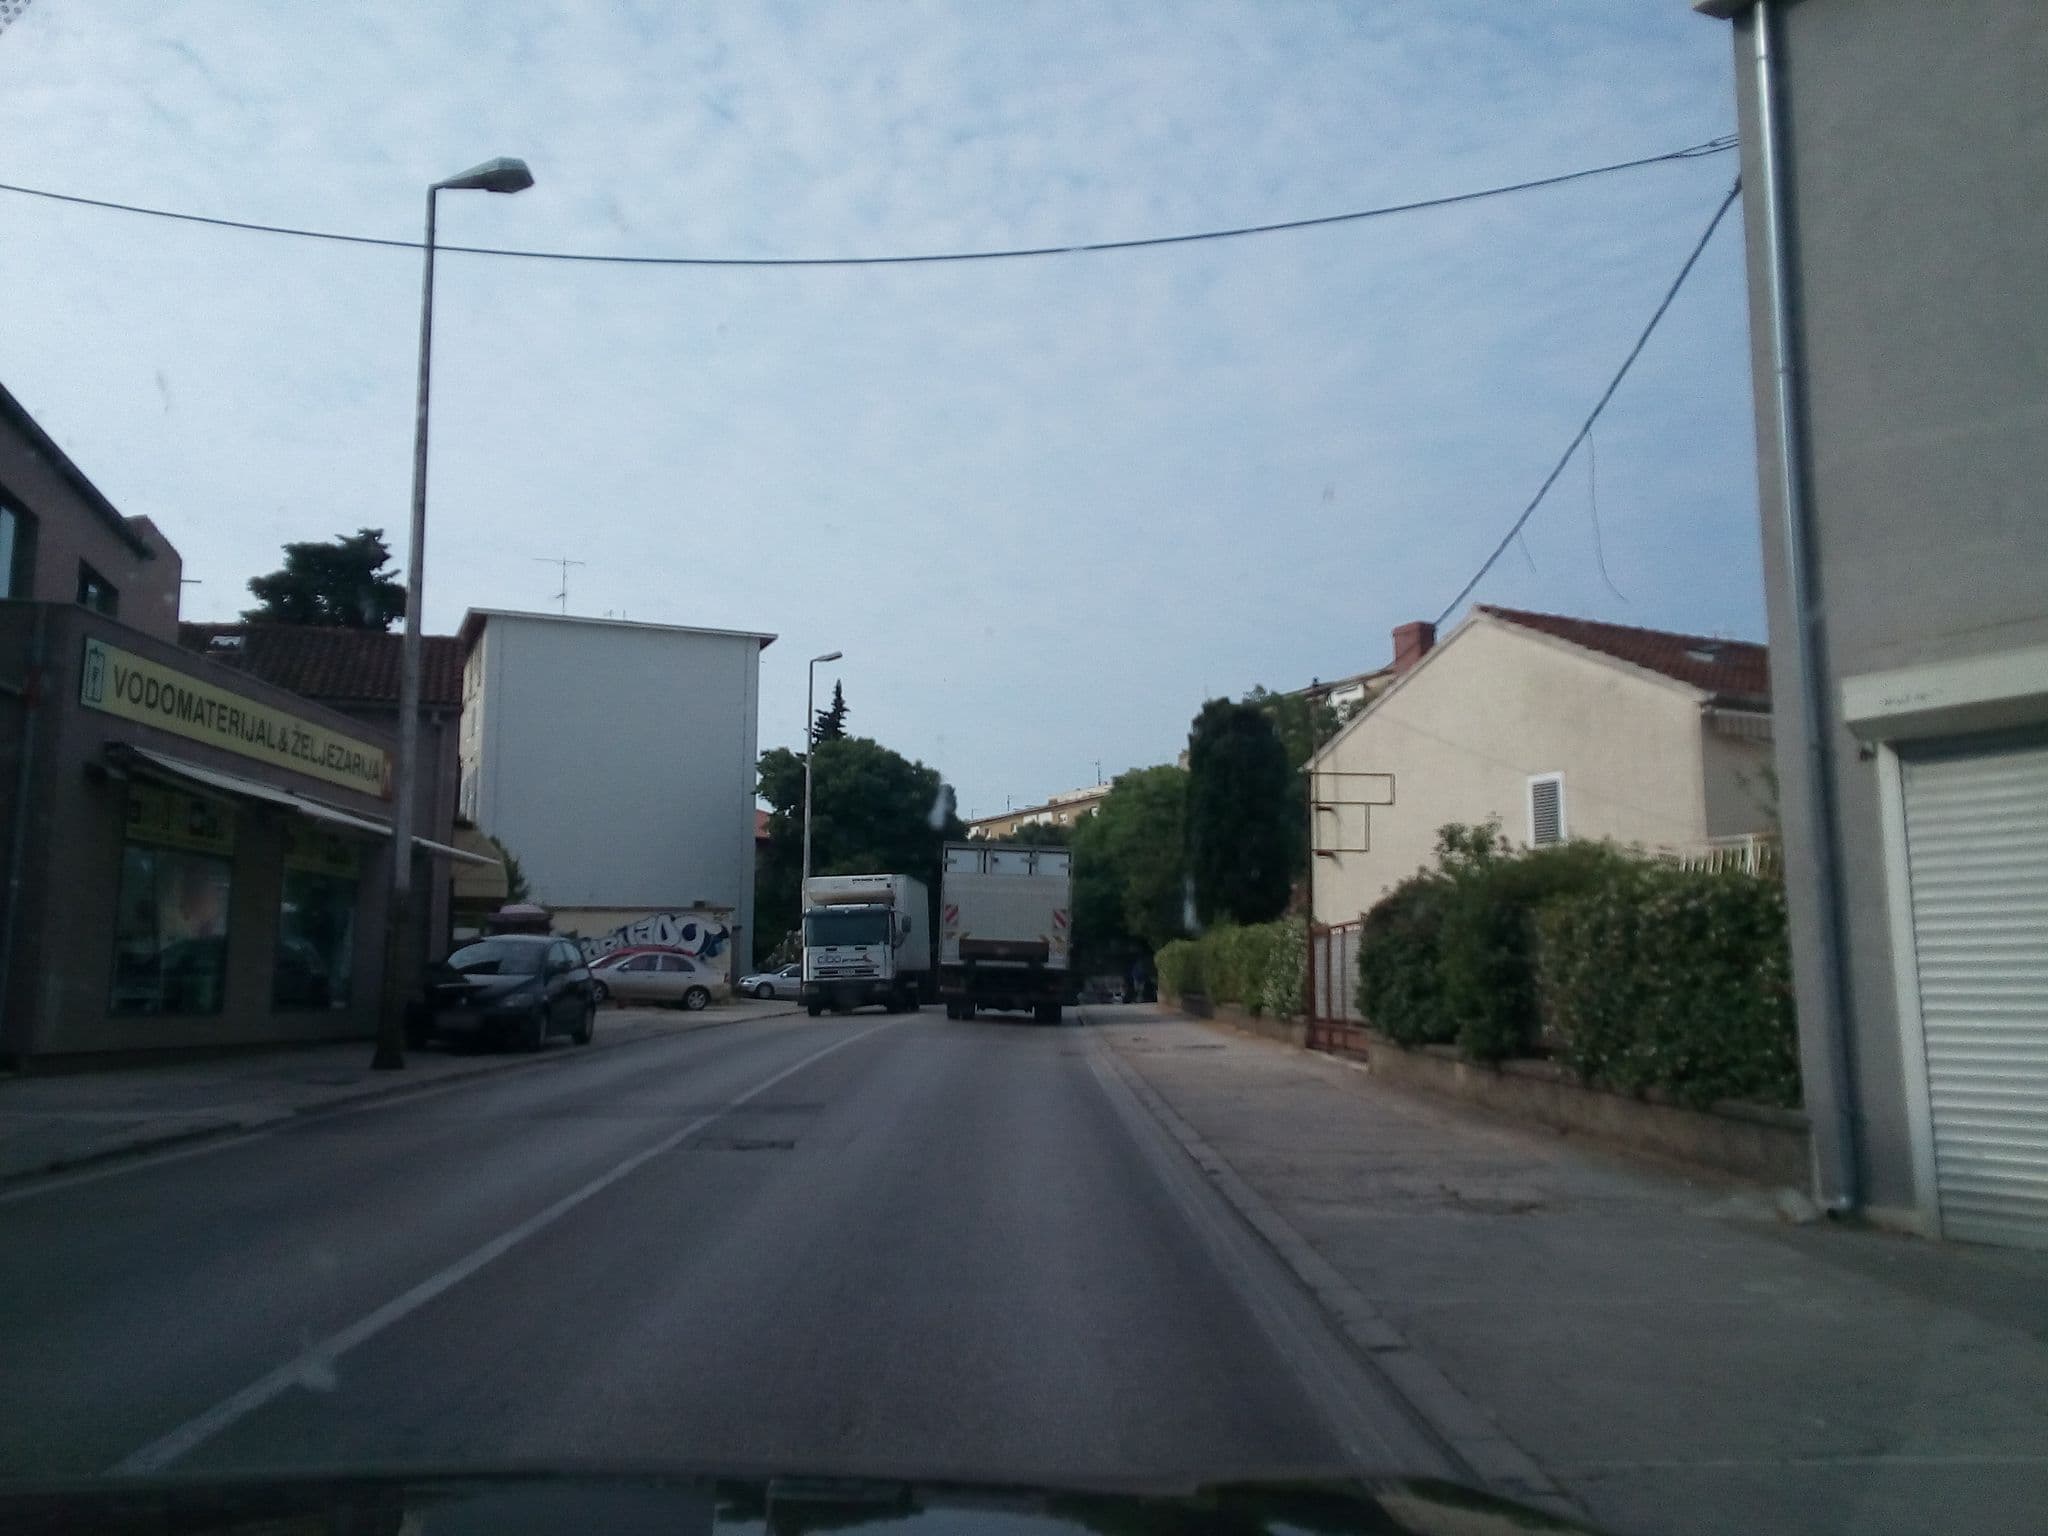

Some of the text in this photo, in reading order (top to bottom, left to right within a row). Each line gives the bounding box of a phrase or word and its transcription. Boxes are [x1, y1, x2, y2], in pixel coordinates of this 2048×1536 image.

[113, 664, 380, 781] VODOMATERIJAL & ŽELJEZARIJA
